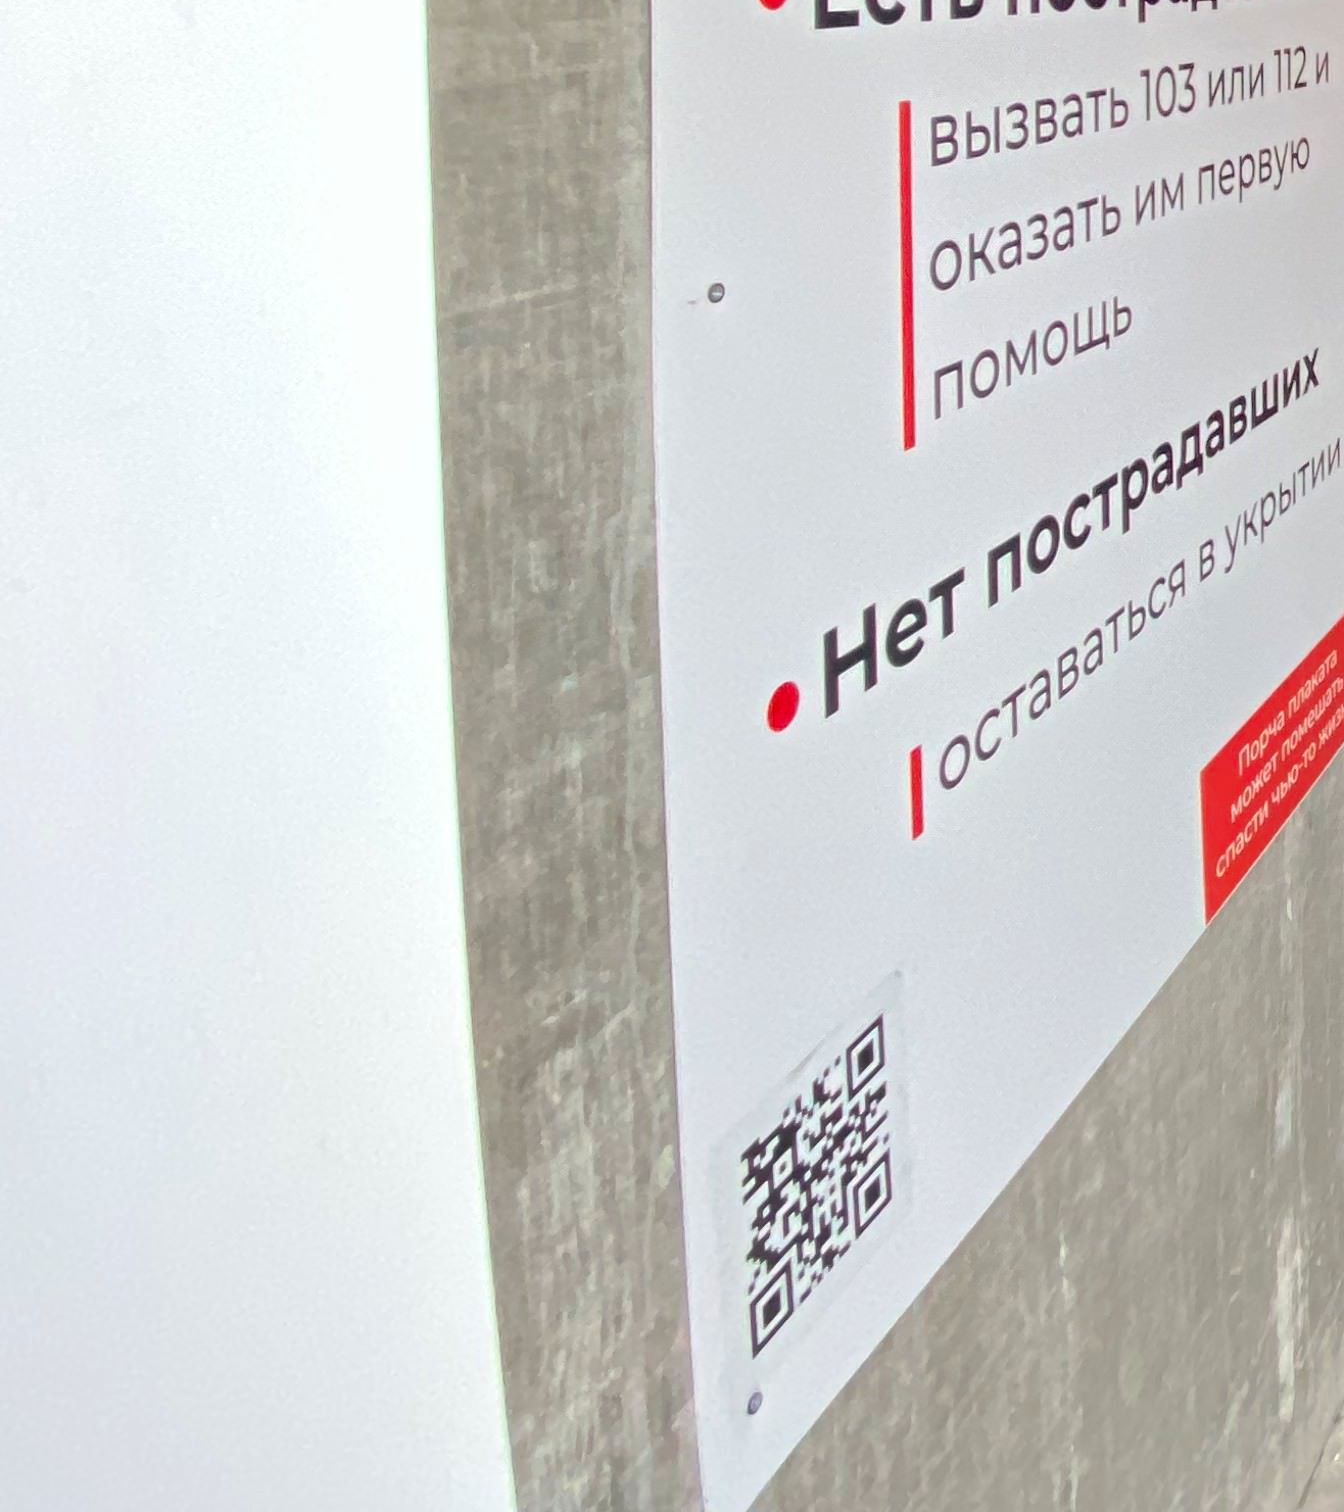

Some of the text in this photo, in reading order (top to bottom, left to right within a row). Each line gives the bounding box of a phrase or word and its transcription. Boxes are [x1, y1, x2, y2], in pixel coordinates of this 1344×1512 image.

[930, 47, 1330, 167] вызвать 103 или 112 и
[929, 135, 1312, 292] оказать им первую
[934, 295, 1134, 420] помощь
[822, 348, 1321, 719] Нет пострадавших
[938, 438, 1342, 791] оставаться в укрытии
[1231, 676, 1344, 824] может помешать
[1238, 649, 1338, 777] Порча плаката
[1215, 804, 1269, 878] спасти
[1271, 742, 1316, 804] чью-то
